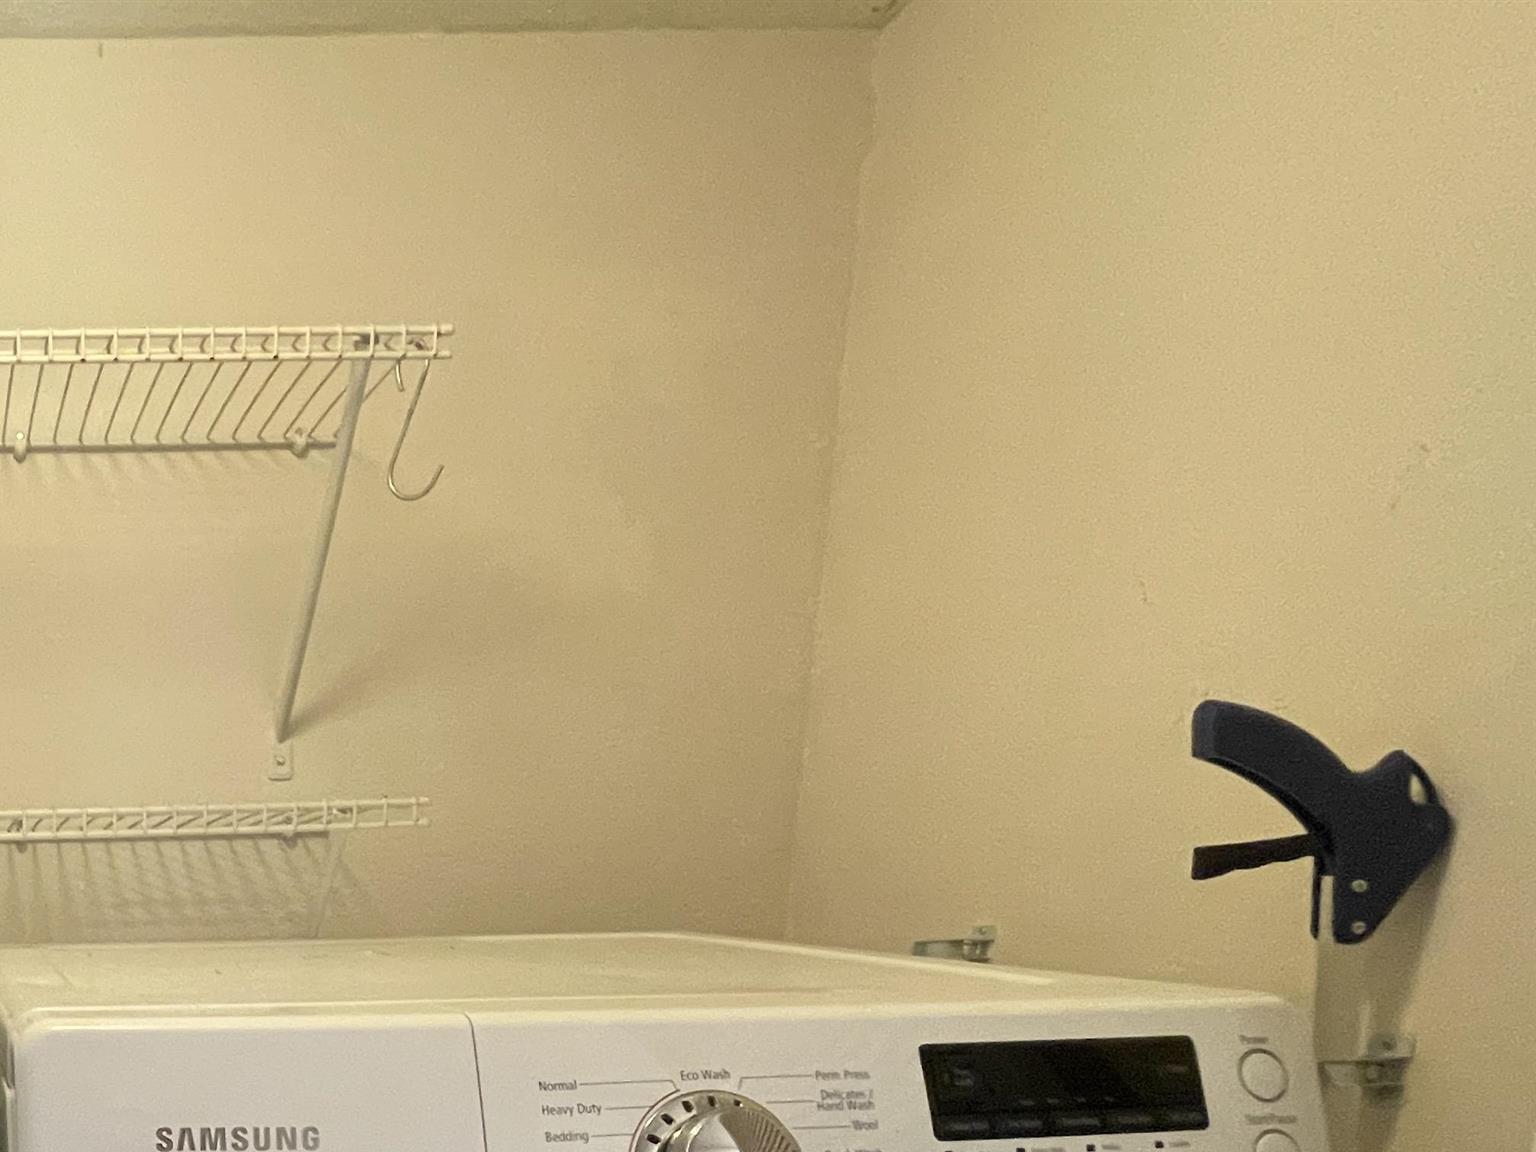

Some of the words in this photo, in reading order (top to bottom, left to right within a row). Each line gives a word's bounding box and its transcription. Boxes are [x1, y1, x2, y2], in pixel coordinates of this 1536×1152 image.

[680, 1070, 699, 1081] Eco
[700, 1068, 731, 1080] Wash
[538, 1079, 578, 1092] Normal
[541, 1104, 574, 1117] Heavy
[577, 1102, 602, 1116] Duty
[155, 1125, 321, 1152] SAMSUNG
[544, 1130, 590, 1144] Bedding
